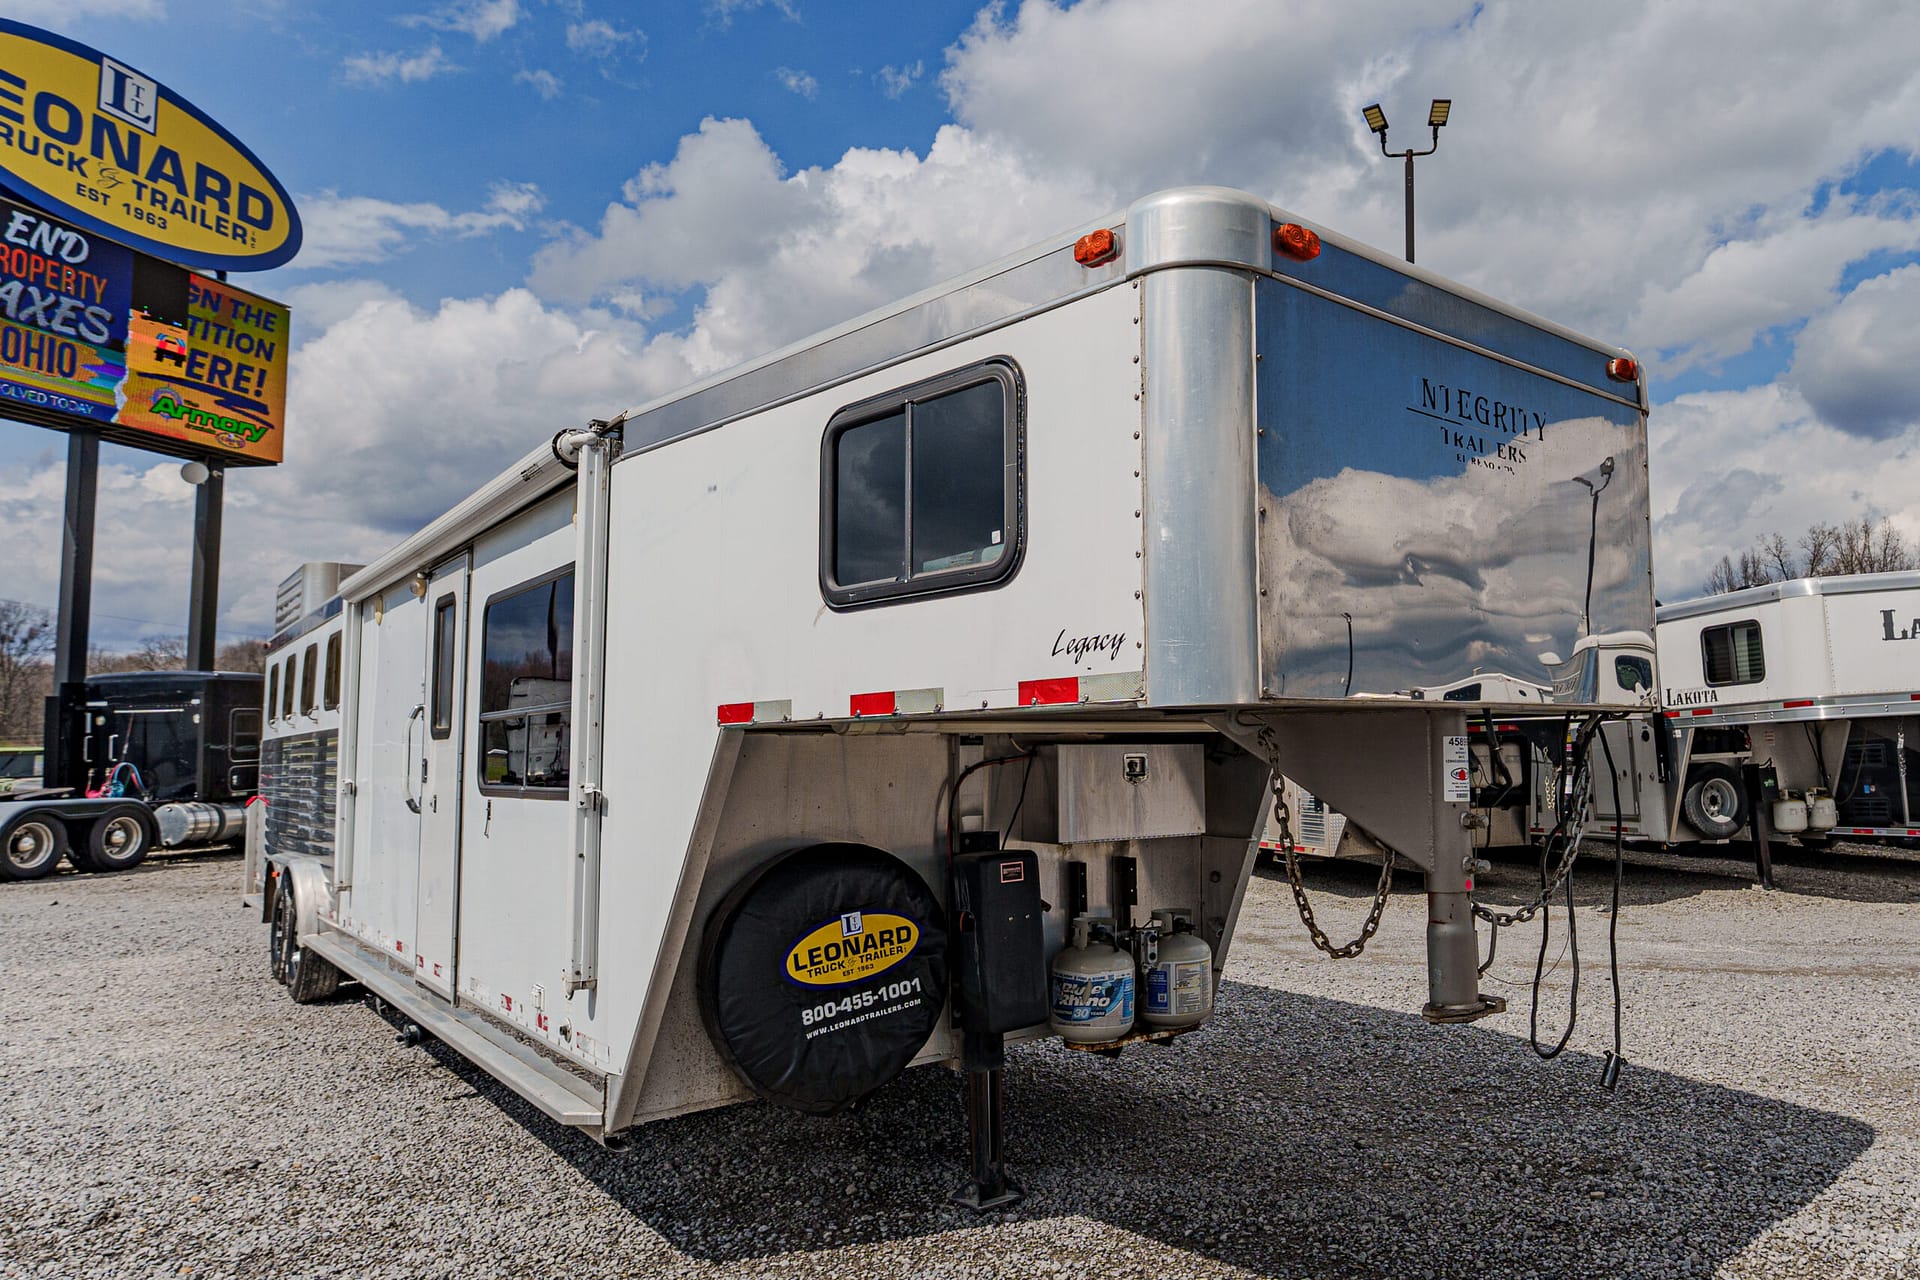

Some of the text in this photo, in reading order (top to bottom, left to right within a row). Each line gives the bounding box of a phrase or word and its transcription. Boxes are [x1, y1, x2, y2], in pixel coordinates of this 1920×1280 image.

[0, 121, 89, 178] RUCK
[132, 179, 248, 246] TRAILER
[76, 183, 168, 230] EST 1963
[4, 210, 90, 264] END
[0, 243, 108, 305] ROPERTY
[187, 315, 276, 362] TITION
[229, 298, 277, 333] THE
[2, 326, 77, 379] OHIO
[185, 348, 267, 398] ERE!
[49, 395, 95, 414] TODAY
[149, 395, 269, 443] Armory
[1051, 628, 1126, 664] Legacy
[1666, 688, 1719, 706] LAKOTA
[793, 925, 912, 972] LEONARD
[807, 960, 846, 978] TRUCK
[859, 945, 904, 963] TRAILER
[842, 969, 854, 977] EST
[801, 977, 921, 1026] 800-455-1001
[806, 999, 921, 1040] WWW.LEONARDTRAILERS.COM
[1073, 1008, 1089, 1018] 30
